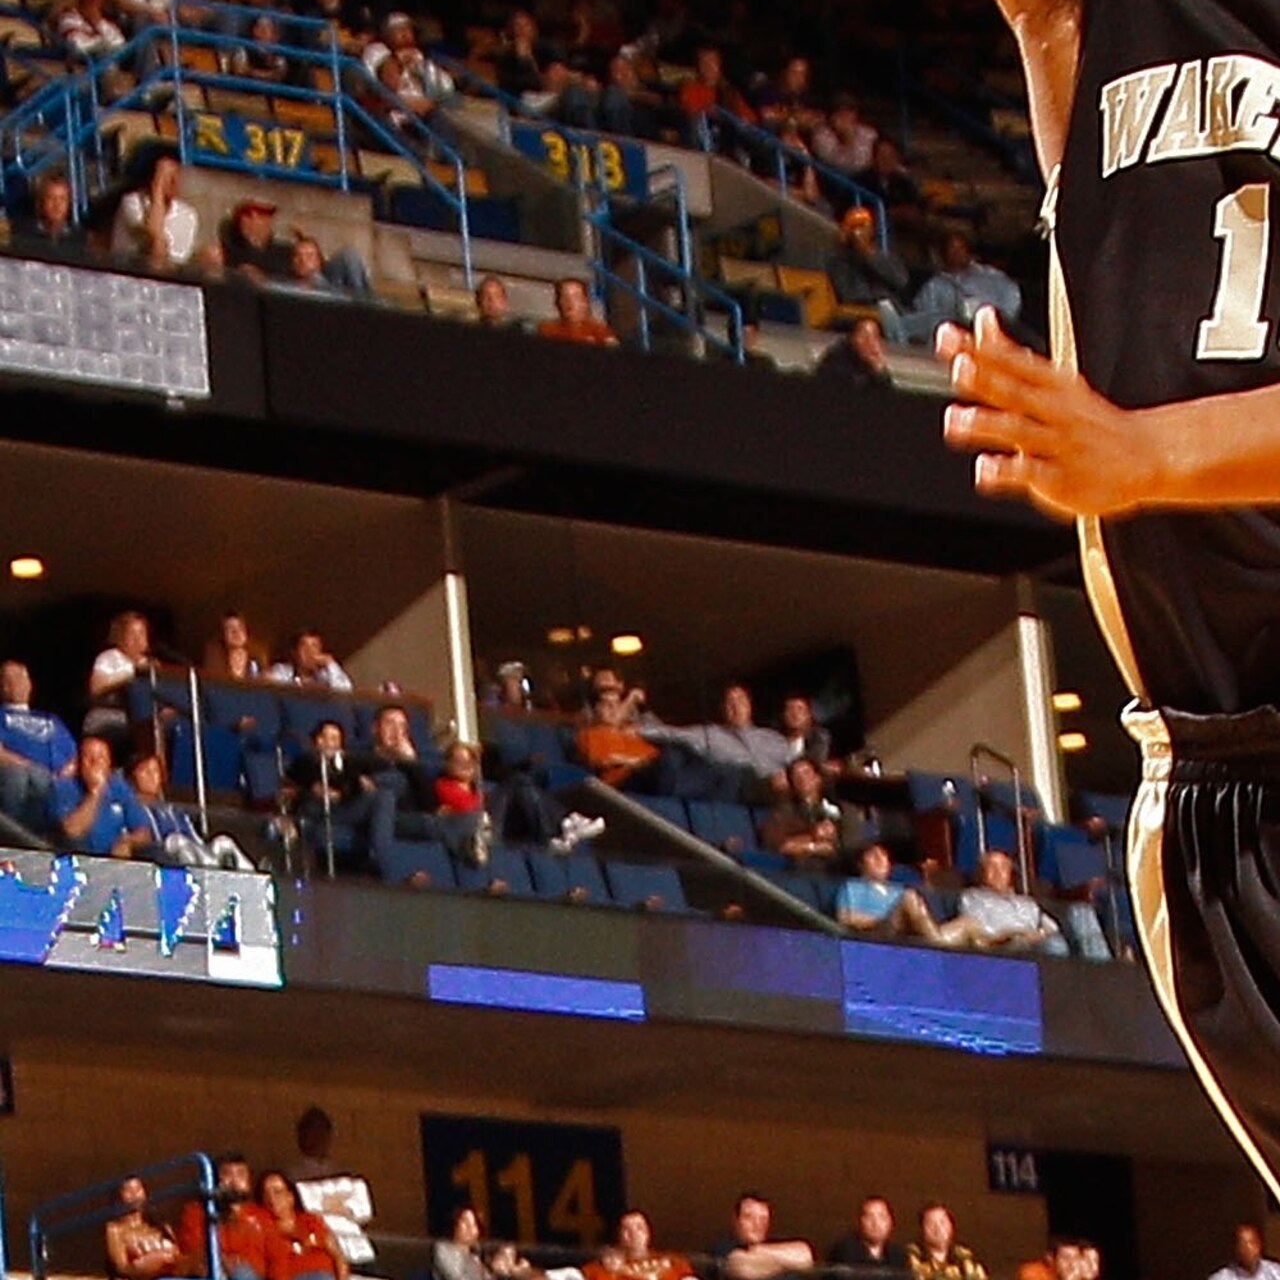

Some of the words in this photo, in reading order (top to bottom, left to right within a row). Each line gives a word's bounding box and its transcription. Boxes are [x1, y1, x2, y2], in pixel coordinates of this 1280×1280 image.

[245, 123, 304, 168] 317
[993, 1151, 1038, 1189] 114
[453, 1149, 603, 1252] 114
